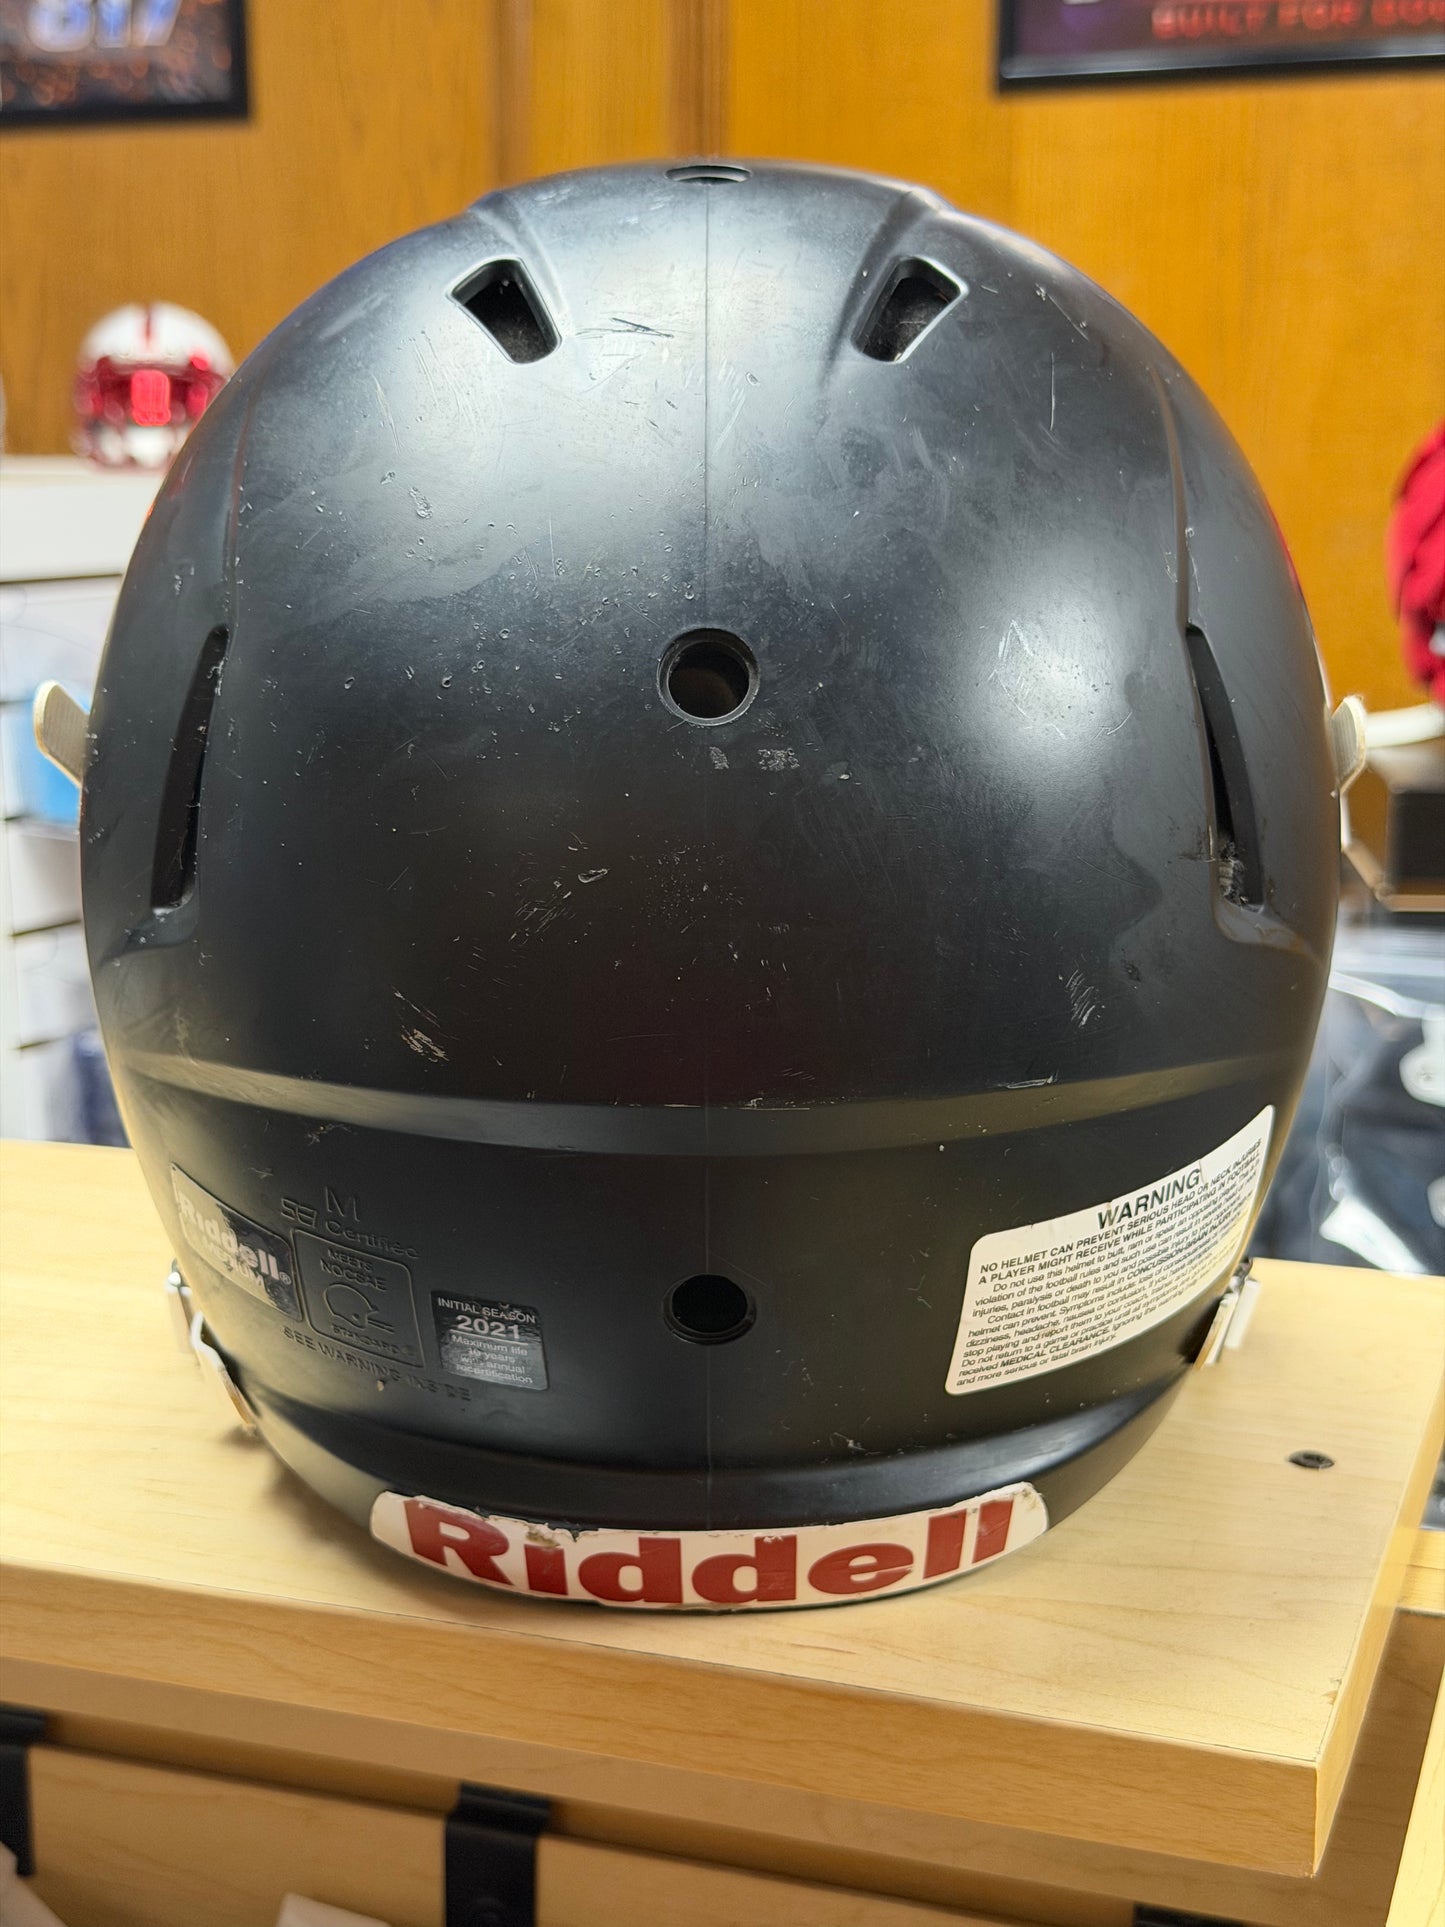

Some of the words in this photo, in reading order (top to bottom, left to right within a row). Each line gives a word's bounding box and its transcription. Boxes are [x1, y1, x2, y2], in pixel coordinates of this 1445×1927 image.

[980, 1262, 998, 1274] NO
[1000, 1249, 1048, 1269] HELMET
[1050, 1242, 1074, 1257] CAN
[1076, 1224, 1125, 1249] PREVENT
[1127, 1205, 1169, 1230] SERIOUS
[1170, 1190, 1196, 1210] HEAD
[1196, 1182, 1209, 1195] OR
[1210, 1166, 1231, 1186] NECK
[1098, 1168, 1200, 1229] WARNING
[978, 1275, 987, 1285] A
[990, 1264, 1035, 1282] PLAYER
[1037, 1253, 1073, 1270] MIGHT
[1075, 1236, 1120, 1260] RECEIVE
[1122, 1222, 1153, 1242] WHILE
[1155, 1187, 1216, 1228] PARTICIPATING
[1217, 1180, 1226, 1191] IN
[972, 1304, 1008, 1317] injuries,
[1010, 1292, 1052, 1310] paralysis
[1054, 1288, 1065, 1297] or
[1065, 1279, 1091, 1293] death
[1092, 1276, 1102, 1285] to
[1102, 1268, 1120, 1283] you
[1120, 1260, 1137, 1274] and
[975, 1292, 1015, 1306] violation
[1016, 1287, 1027, 1297] of
[1028, 1284, 1043, 1294] the
[1045, 1273, 1078, 1289] football
[1079, 1266, 1101, 1279] rules
[1102, 1257, 1120, 1271] and
[1120, 1250, 1141, 1264] such
[992, 1283, 1008, 1293] Do
[1009, 1277, 1025, 1289] not
[1027, 1274, 1045, 1284] use
[1046, 1268, 1063, 1279] this
[1064, 1257, 1095, 1273] helmet
[1096, 1254, 1106, 1263] to
[1106, 1246, 1125, 1259] butt,
[438, 1297, 480, 1314] INITIAL
[482, 1306, 536, 1324] SEASON
[967, 1324, 1001, 1337] helmet
[1001, 1320, 1020, 1331] can
[1059, 1294, 1105, 1315] Symptoms
[987, 1309, 1025, 1324] Contact
[1025, 1306, 1035, 1315] in
[1037, 1295, 1070, 1311] football
[1071, 1290, 1091, 1301] may
[1091, 1279, 1116, 1294] result
[451, 1334, 508, 1352] Maximum
[511, 1346, 528, 1356] life
[456, 1314, 520, 1340] 2021
[962, 1348, 984, 1358] stop
[985, 1339, 1020, 1355] playing
[1021, 1333, 1040, 1345] and
[1041, 1324, 1069, 1339] report
[1070, 1317, 1092, 1330] them
[965, 1333, 1011, 1348] dizziness,
[1013, 1319, 1060, 1337] headache,
[1063, 1307, 1095, 1322] nausea
[1096, 1302, 1106, 1311] or
[283, 1324, 318, 1350] SEE
[318, 1341, 401, 1381] WARNING
[483, 1351, 515, 1363] years
[486, 1360, 526, 1374] annual
[956, 1375, 976, 1386] and
[976, 1371, 1002, 1382] more
[1003, 1361, 1037, 1375] serious
[1038, 1357, 1050, 1366] or
[958, 1362, 999, 1377] received
[1000, 1350, 1046, 1367] MEDICAL
[1049, 1326, 1109, 1354] CLEARANCE.
[961, 1358, 976, 1368] Do
[977, 1354, 994, 1364] not
[994, 1348, 1023, 1360] return
[1024, 1345, 1034, 1353] to
[1042, 1334, 1069, 1349] game
[403, 1498, 1015, 1605] Riddell
